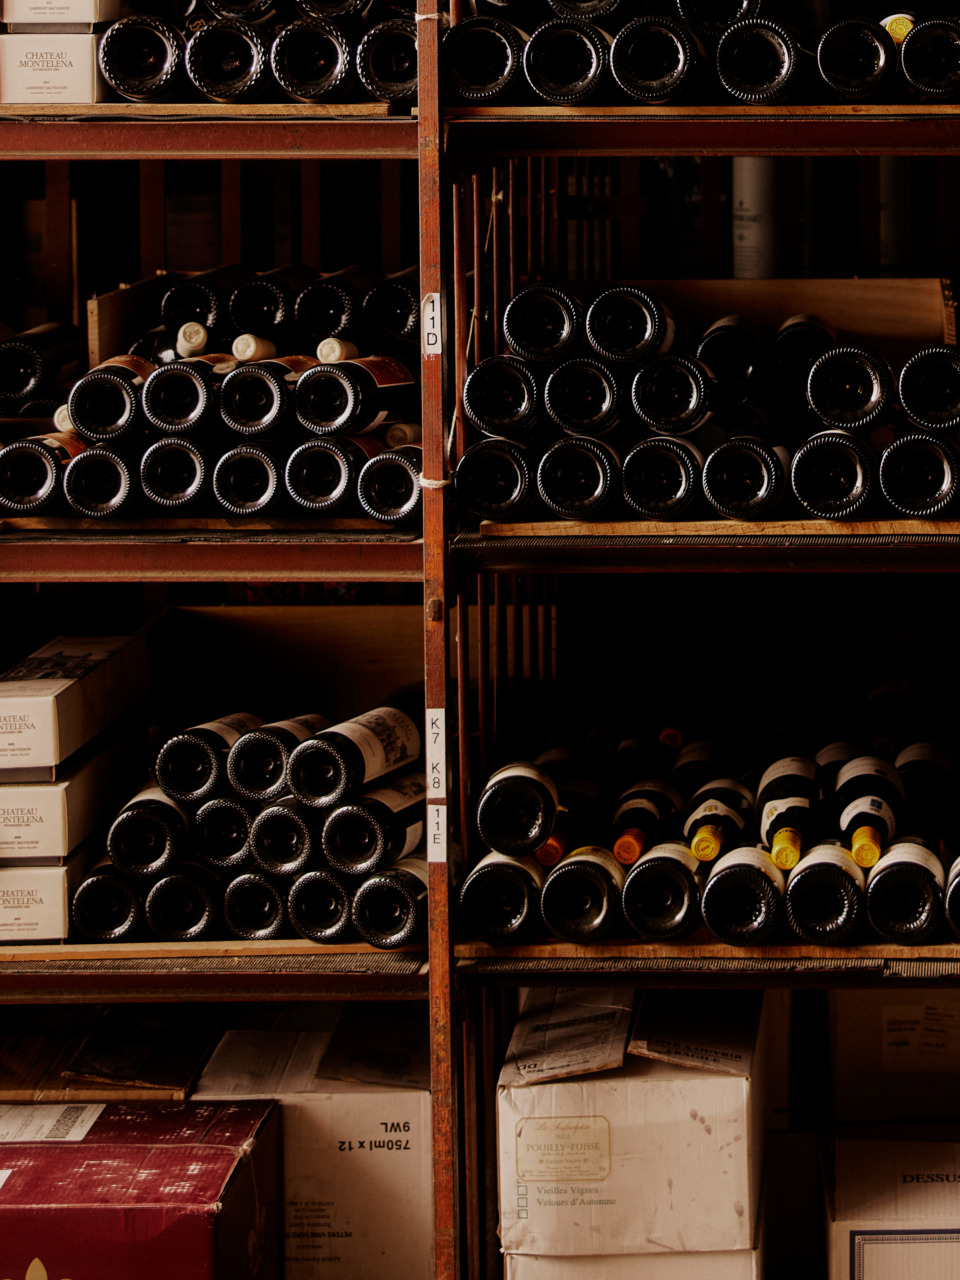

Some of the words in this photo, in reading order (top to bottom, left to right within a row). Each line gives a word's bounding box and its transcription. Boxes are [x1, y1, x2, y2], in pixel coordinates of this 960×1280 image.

[25, 52, 67, 60] CHATEAU
[19, 60, 74, 68] MONTELENA
[427, 299, 438, 346] 11D
[431, 717, 440, 744] K7
[431, 762, 441, 789] K8
[433, 808, 441, 844] 11E
[380, 1121, 411, 1132] 9WL
[338, 1141, 353, 1151] 12
[358, 1141, 365, 1149] x
[369, 1139, 411, 1151] 750ml
[536, 1186, 568, 1195] Vieilles
[571, 1186, 599, 1196] Vignes
[537, 1198, 569, 1206] Velours
